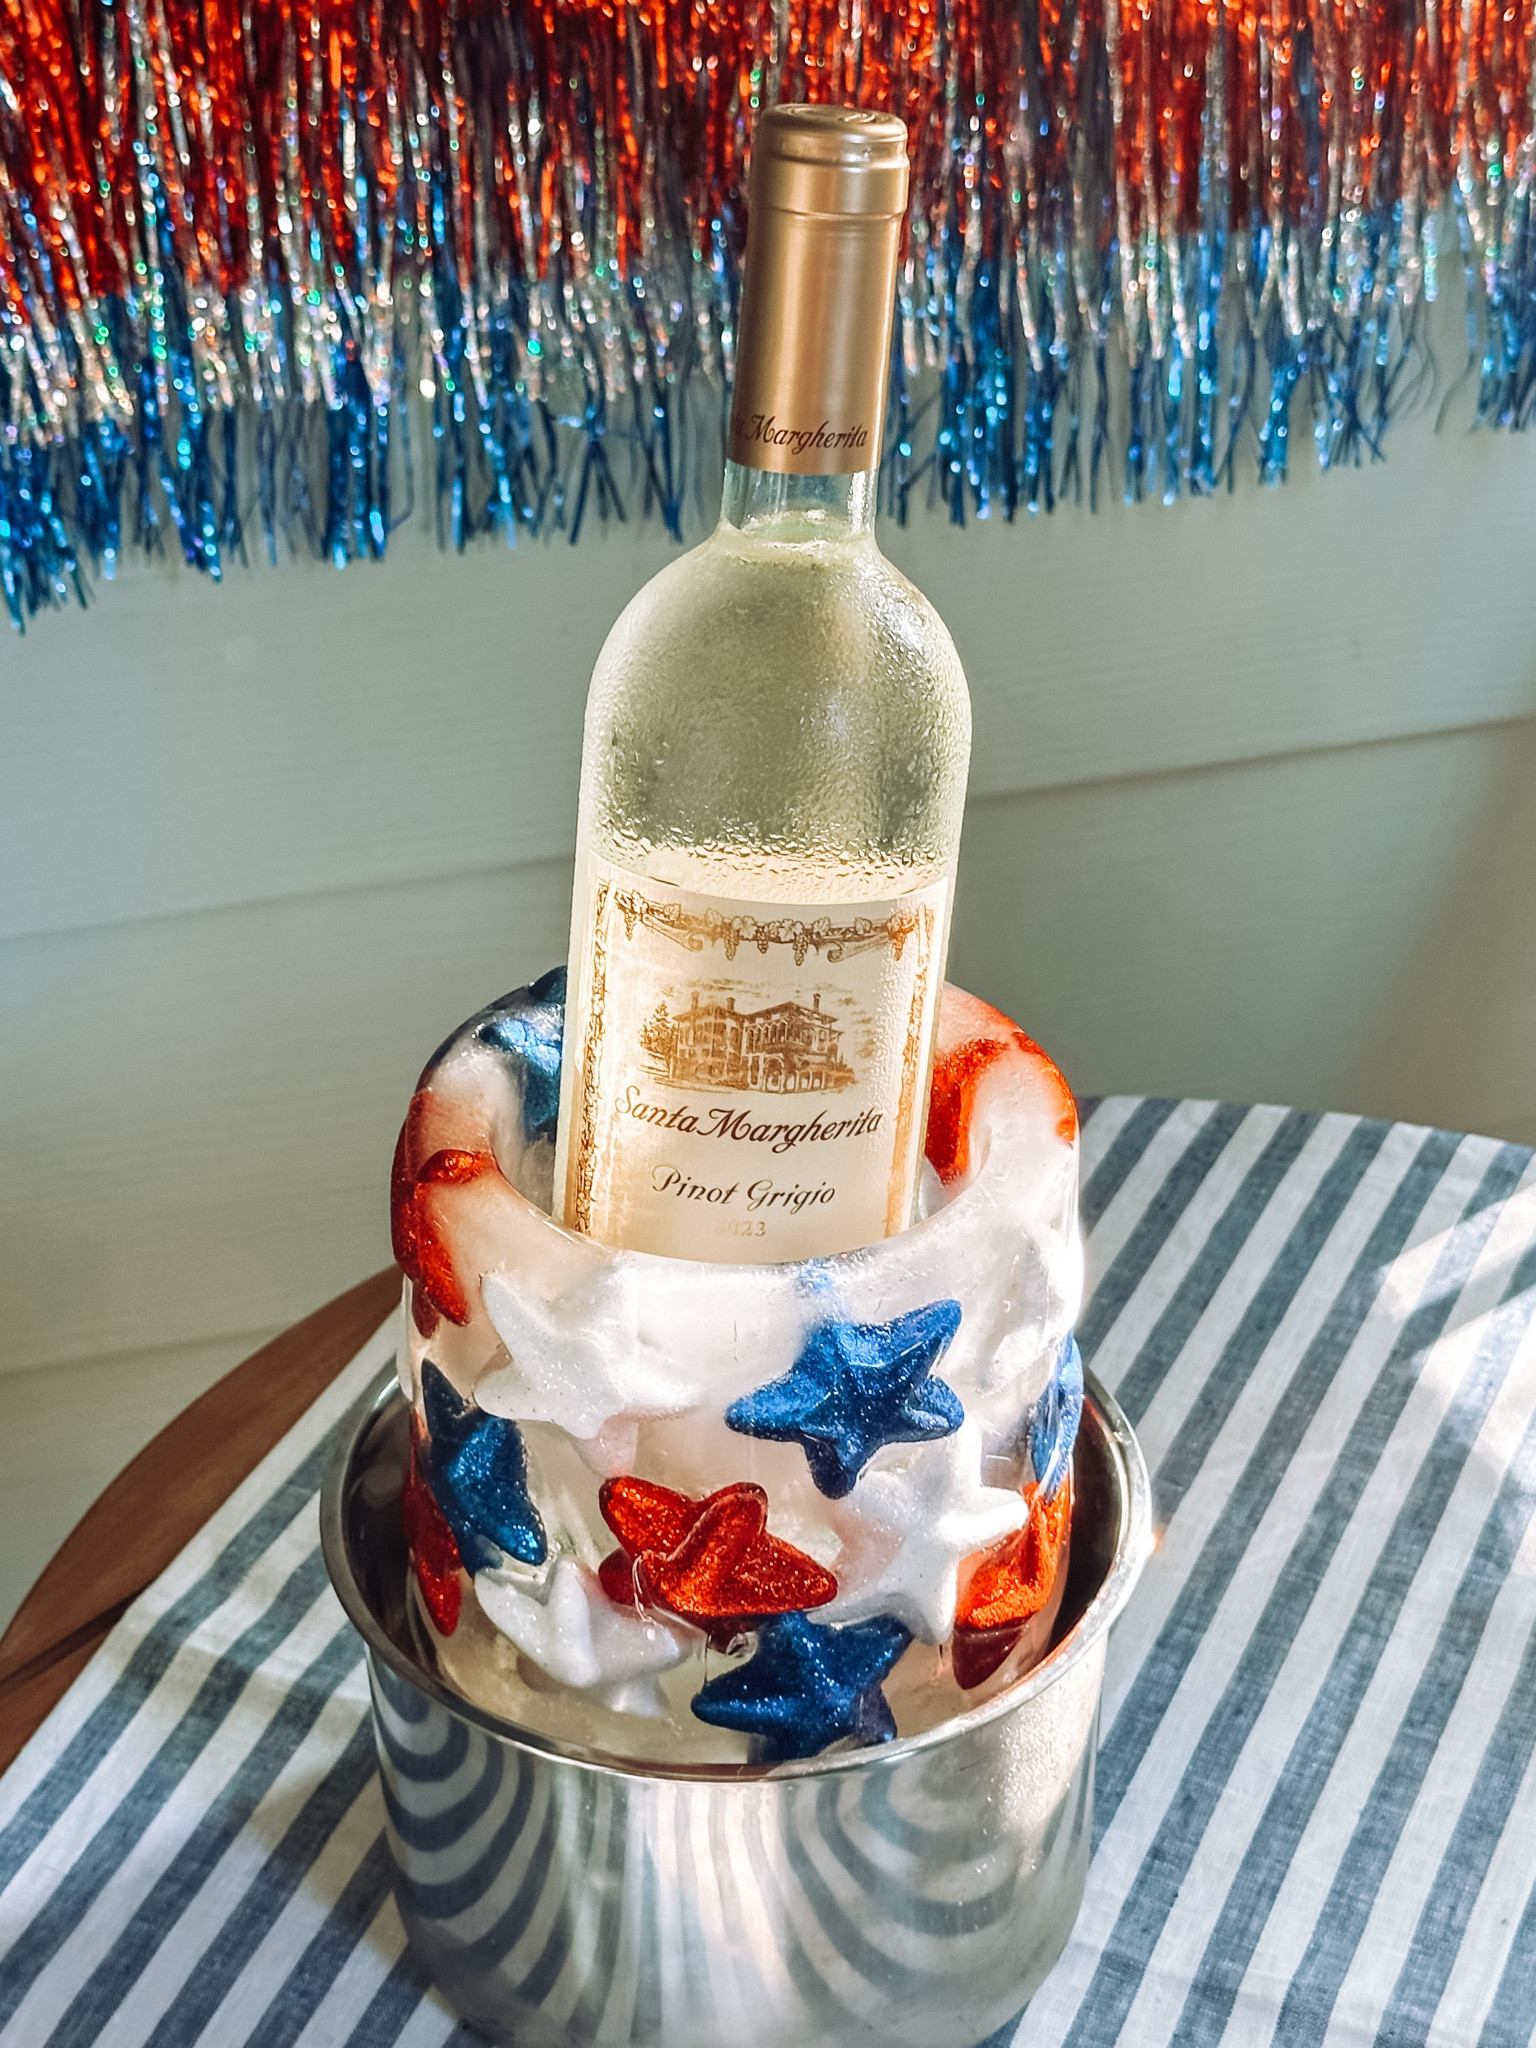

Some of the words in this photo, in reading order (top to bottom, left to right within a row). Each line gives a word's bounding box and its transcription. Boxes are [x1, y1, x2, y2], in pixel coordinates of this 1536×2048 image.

[746, 414, 868, 455] Margherita
[615, 1085, 700, 1133] Santa
[697, 1107, 883, 1153] Margherita
[651, 1164, 740, 1205] Pinot
[747, 1179, 835, 1214] Grigio
